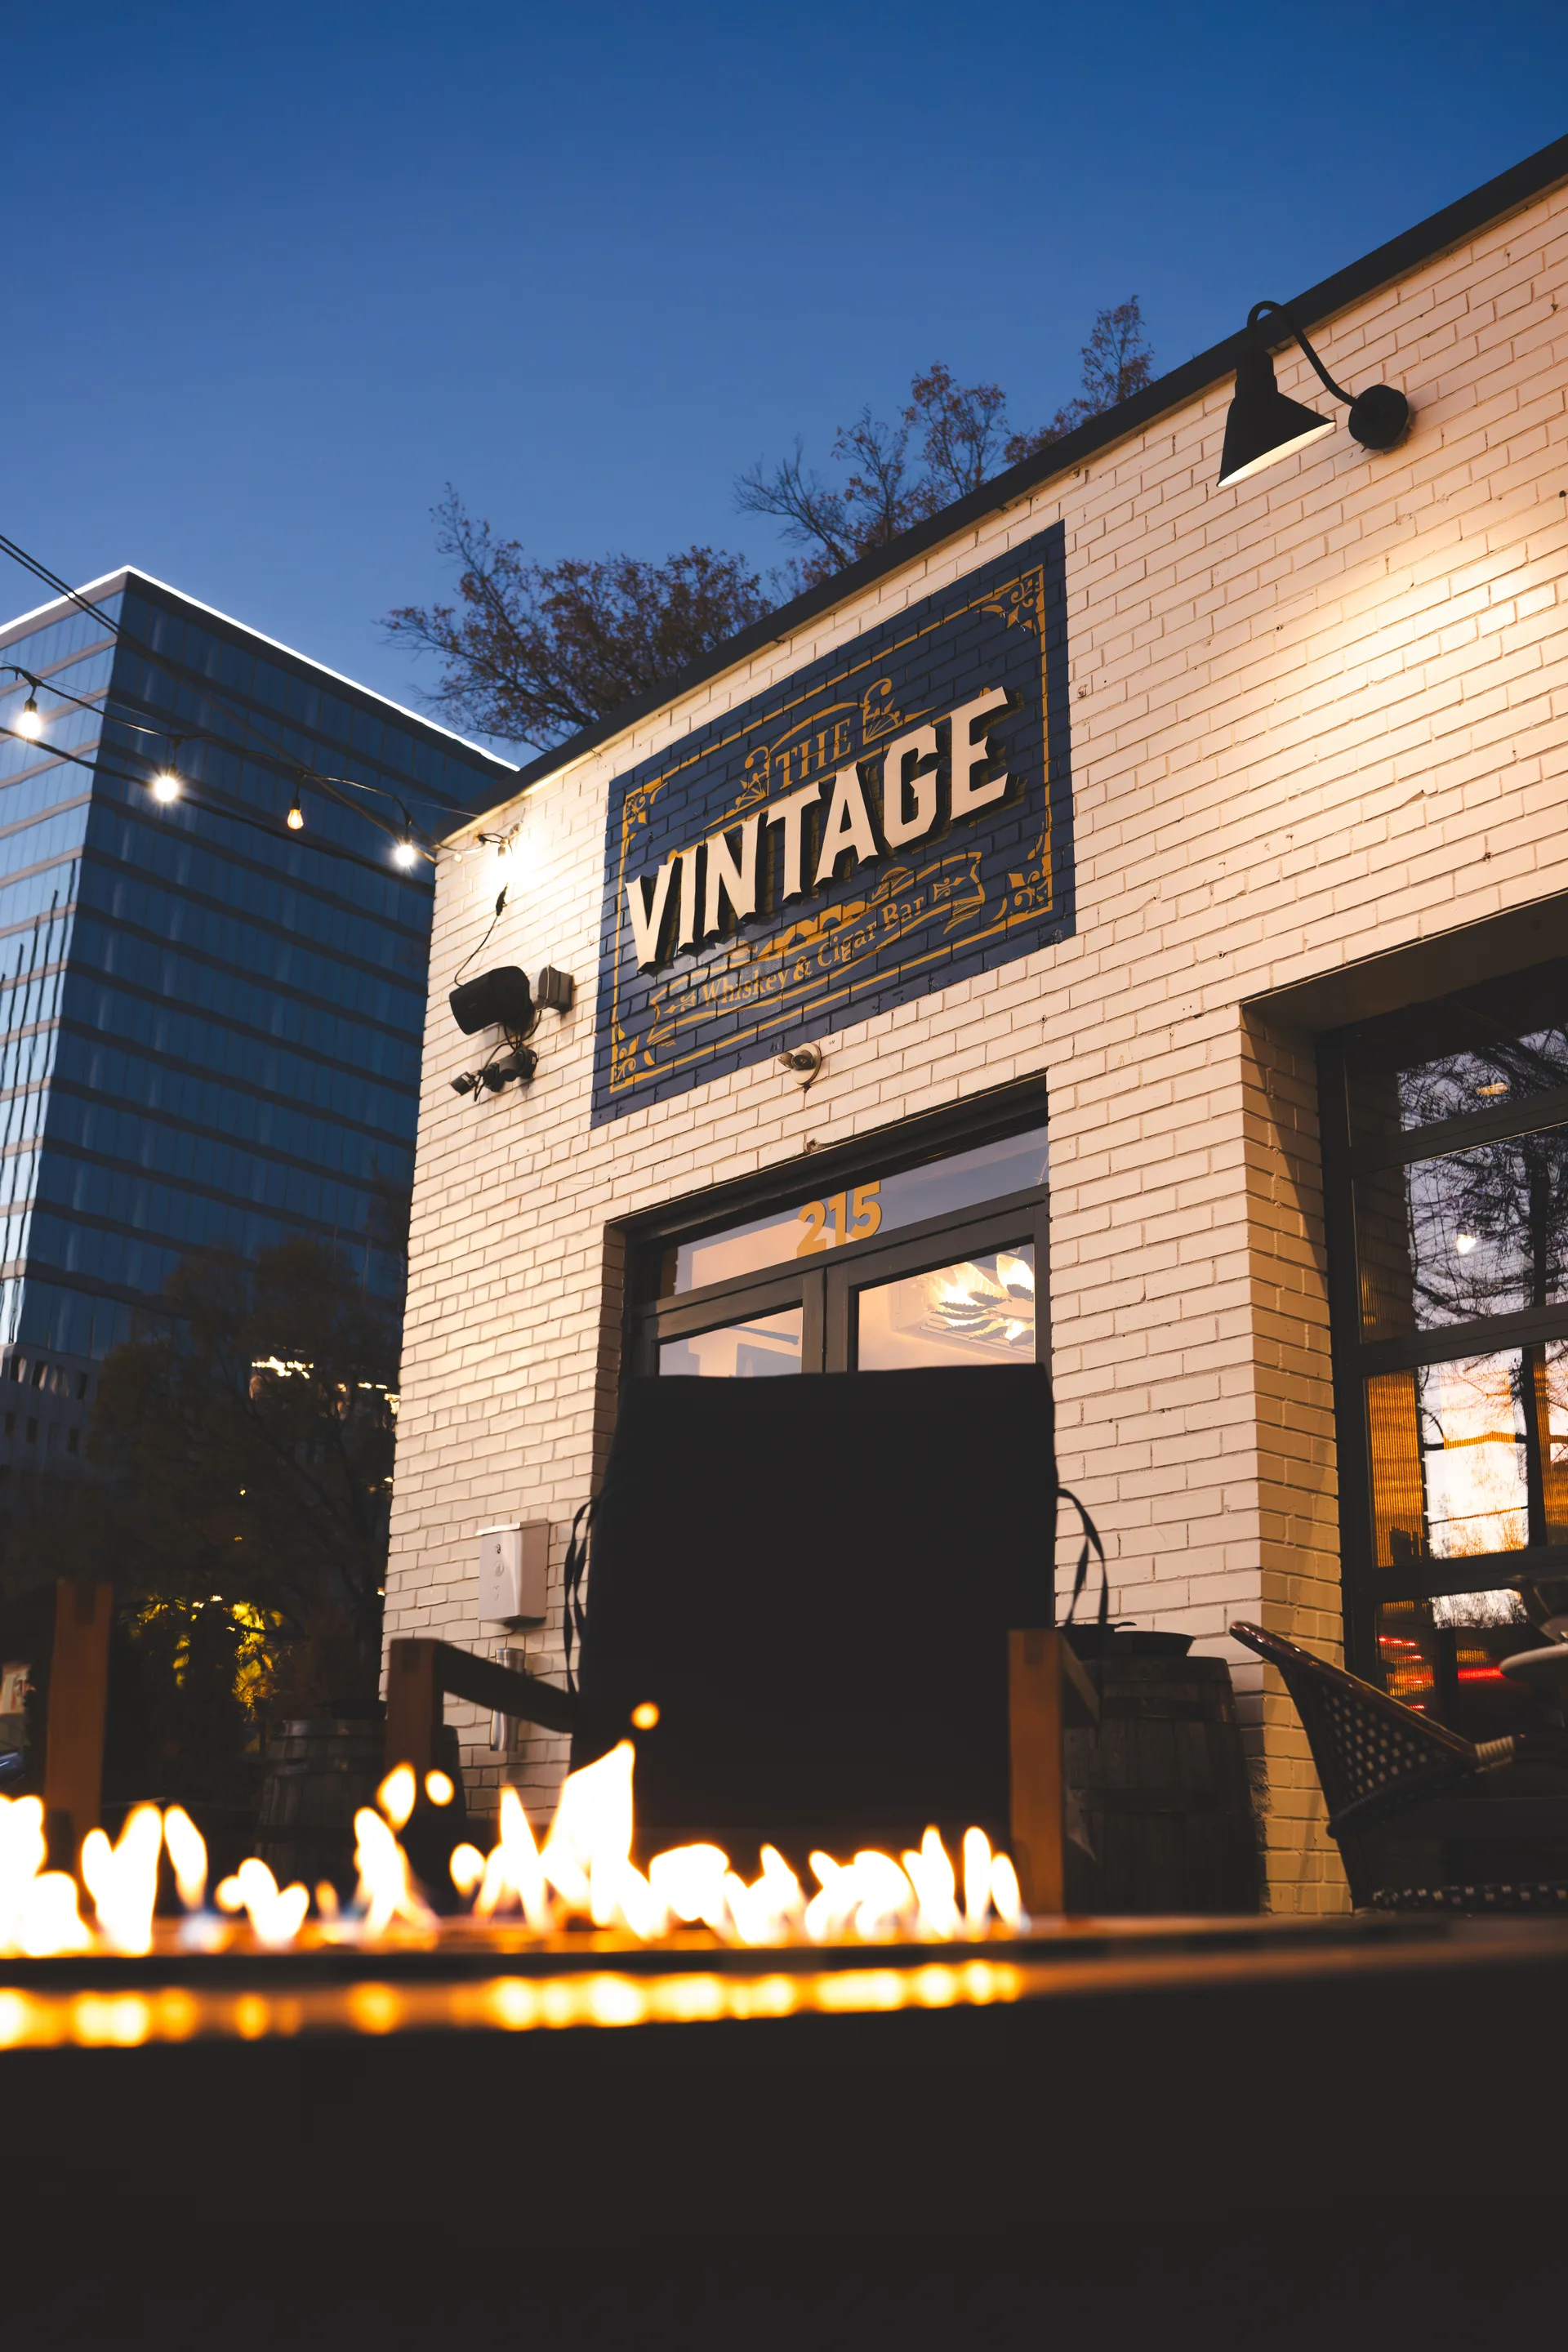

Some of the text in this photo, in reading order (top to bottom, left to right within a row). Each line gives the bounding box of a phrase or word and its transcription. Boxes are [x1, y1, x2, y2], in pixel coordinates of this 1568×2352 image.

[775, 719, 851, 790] THE
[626, 686, 1009, 972] VINTAGE
[701, 896, 924, 1007] Whiskey & Cigar Bar
[796, 1180, 882, 1258] 215
